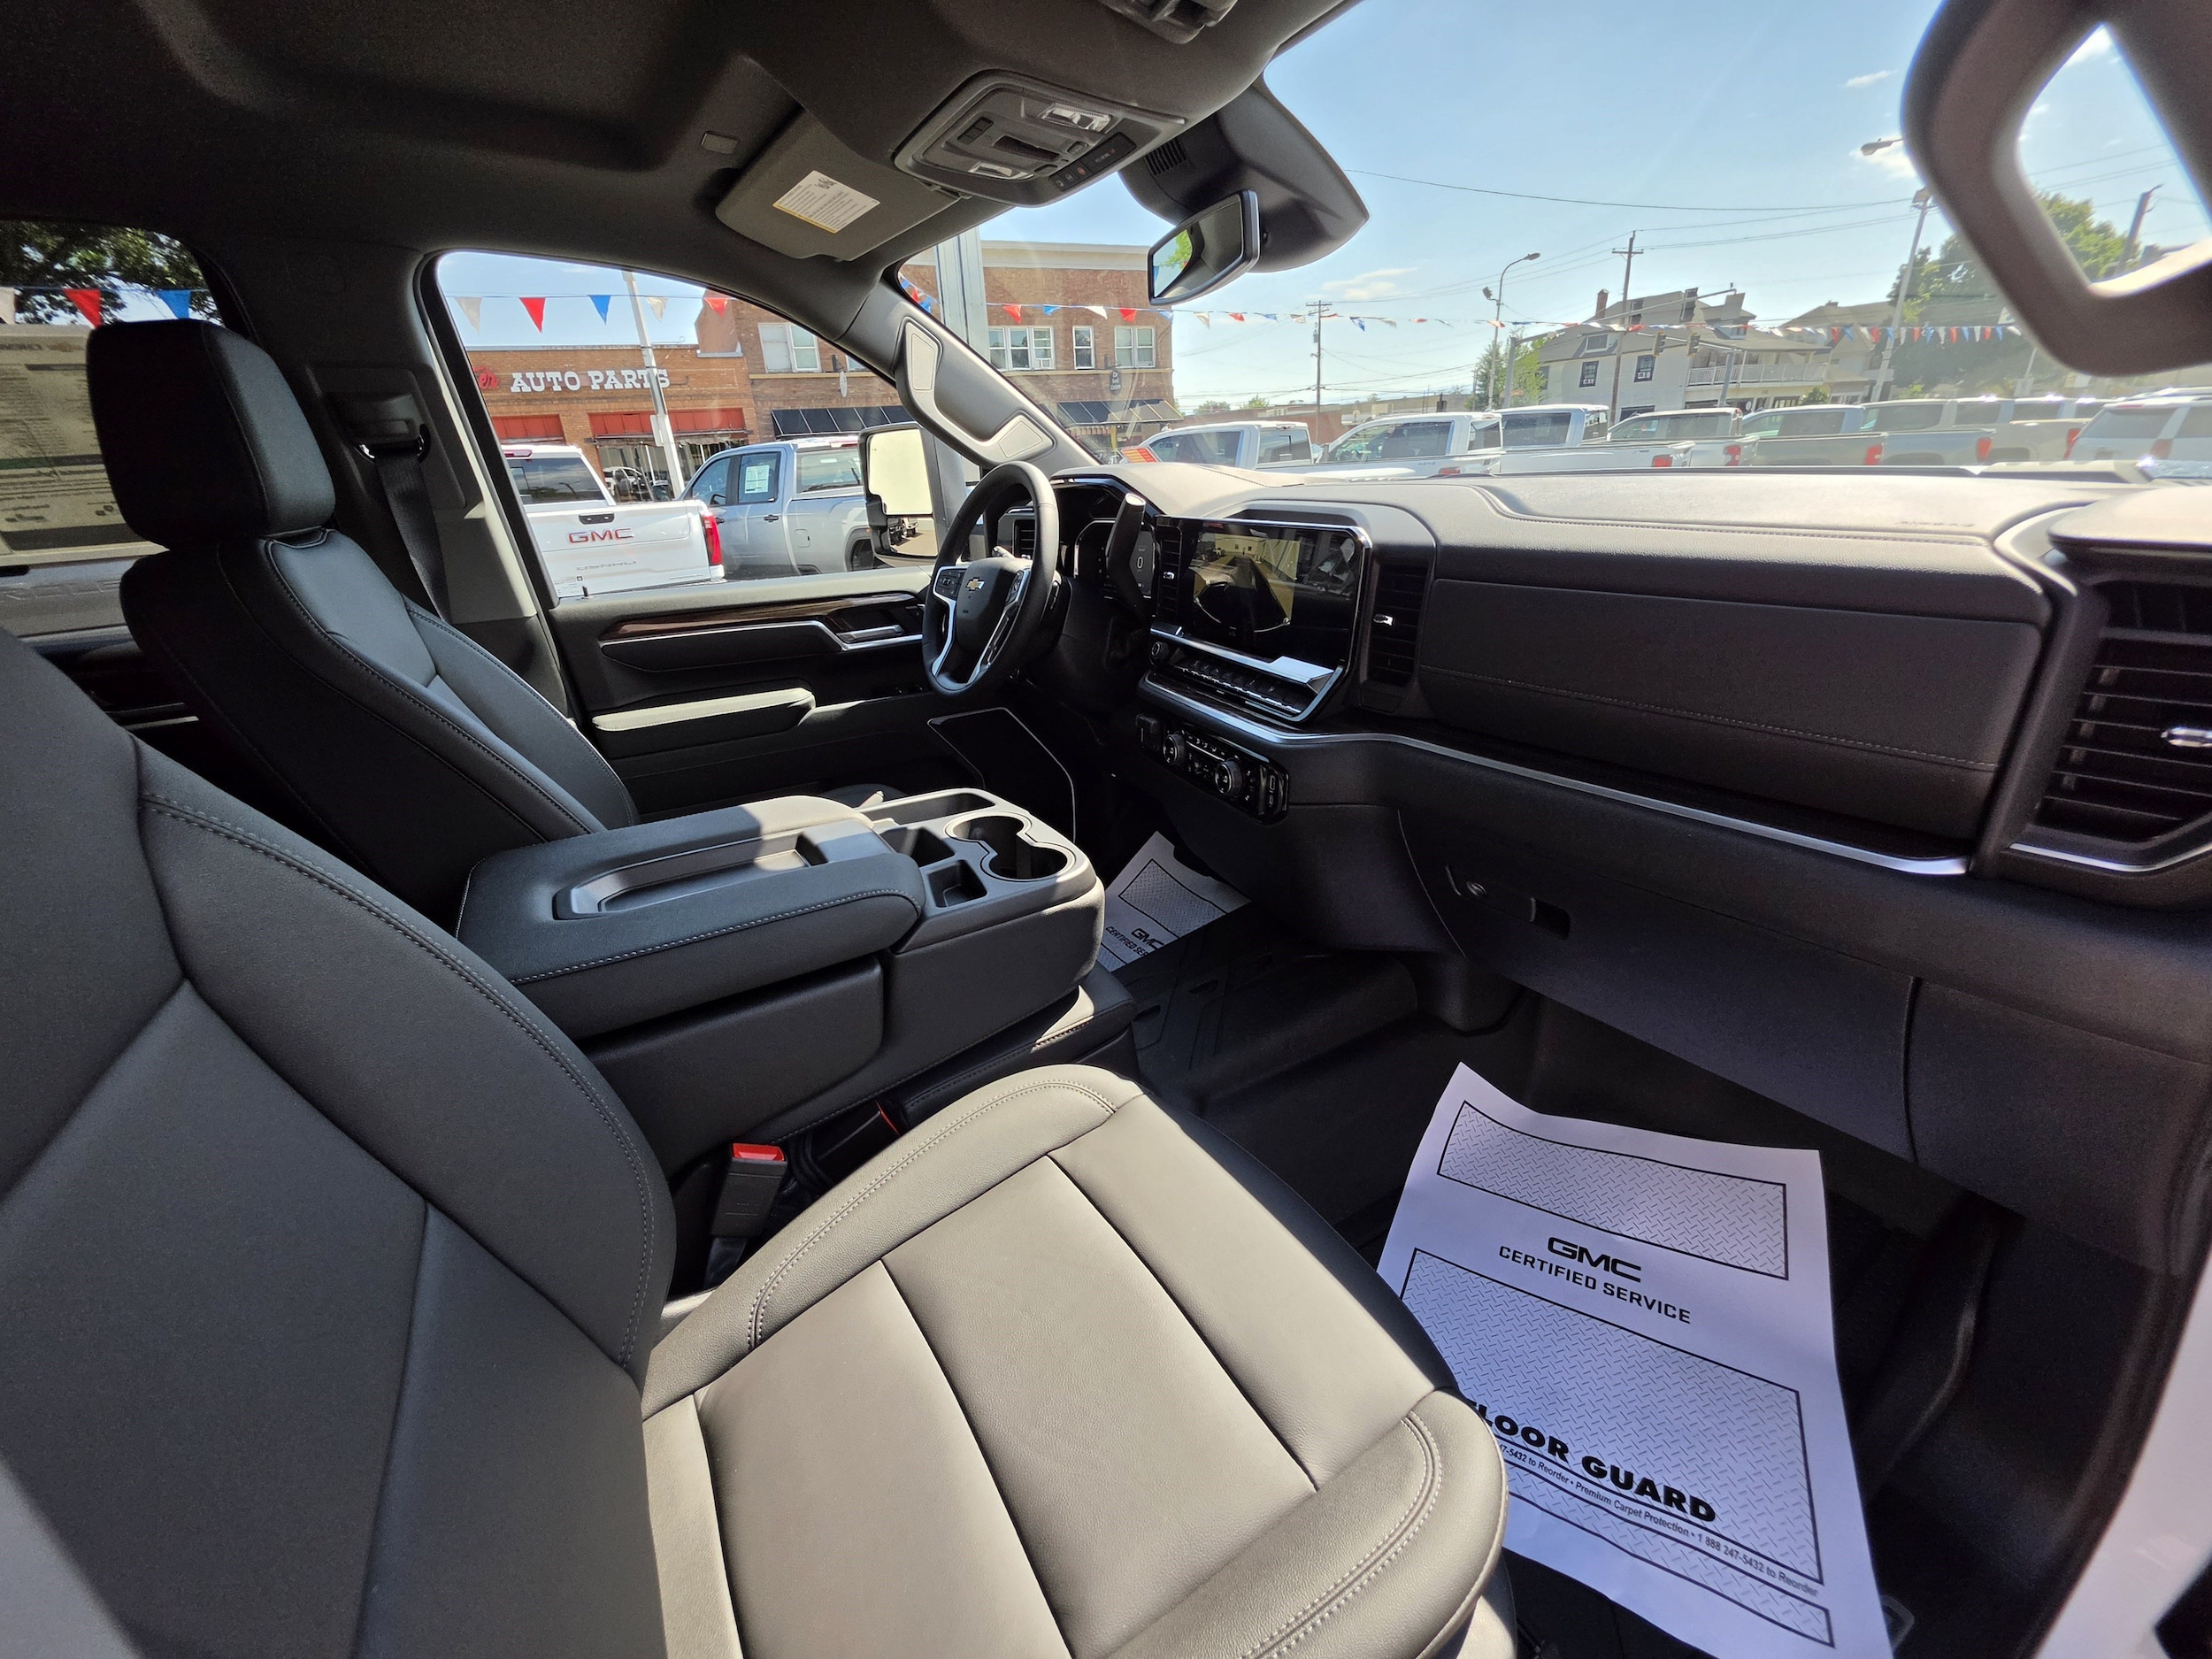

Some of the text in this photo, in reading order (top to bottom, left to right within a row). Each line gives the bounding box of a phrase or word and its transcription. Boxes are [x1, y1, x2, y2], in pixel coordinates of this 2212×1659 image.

[511, 371, 581, 393] AUTO
[588, 369, 671, 390] PARTS
[568, 527, 634, 544] GMC
[1105, 926, 1138, 949] CERTIFIED
[1131, 927, 1164, 950] GMC
[1548, 1237, 1641, 1283] GMC
[1499, 1246, 1691, 1325] CERTIFIED SERVICE
[1581, 1455, 1716, 1522] GUARD
[1499, 1444, 1819, 1597] 7-5432 to Reorder Premium Carpet Protection 1 888 247-5432 to Reorder
